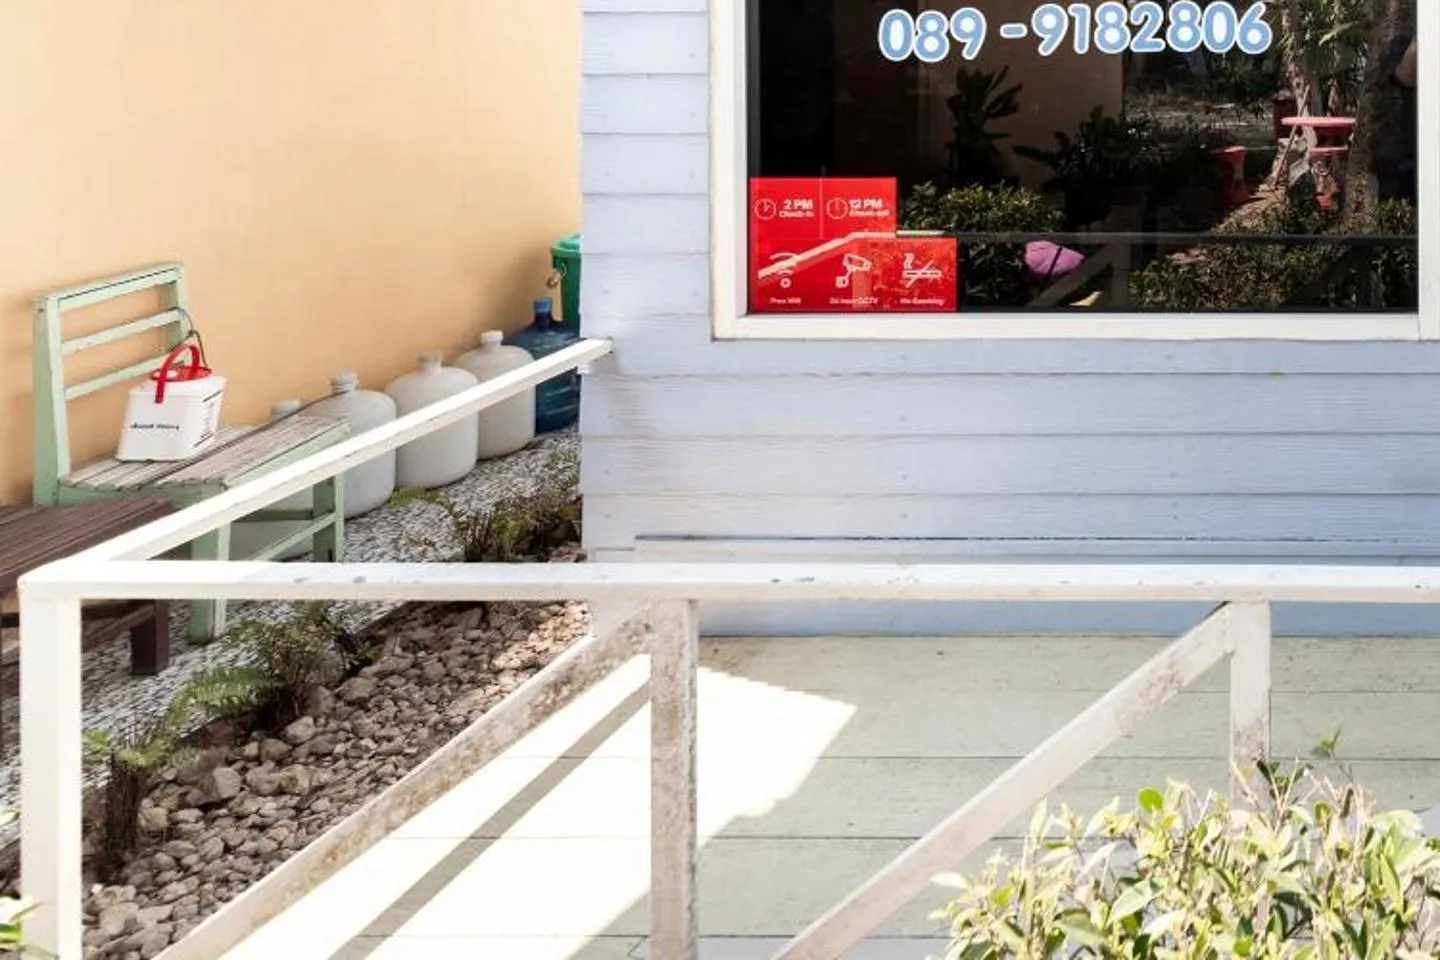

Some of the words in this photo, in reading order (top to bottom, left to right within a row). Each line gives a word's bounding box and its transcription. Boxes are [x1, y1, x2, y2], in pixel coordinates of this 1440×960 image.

[783, 199, 792, 210] 2
[794, 199, 813, 210] PM
[849, 199, 861, 210] 12
[863, 199, 883, 210] PM
